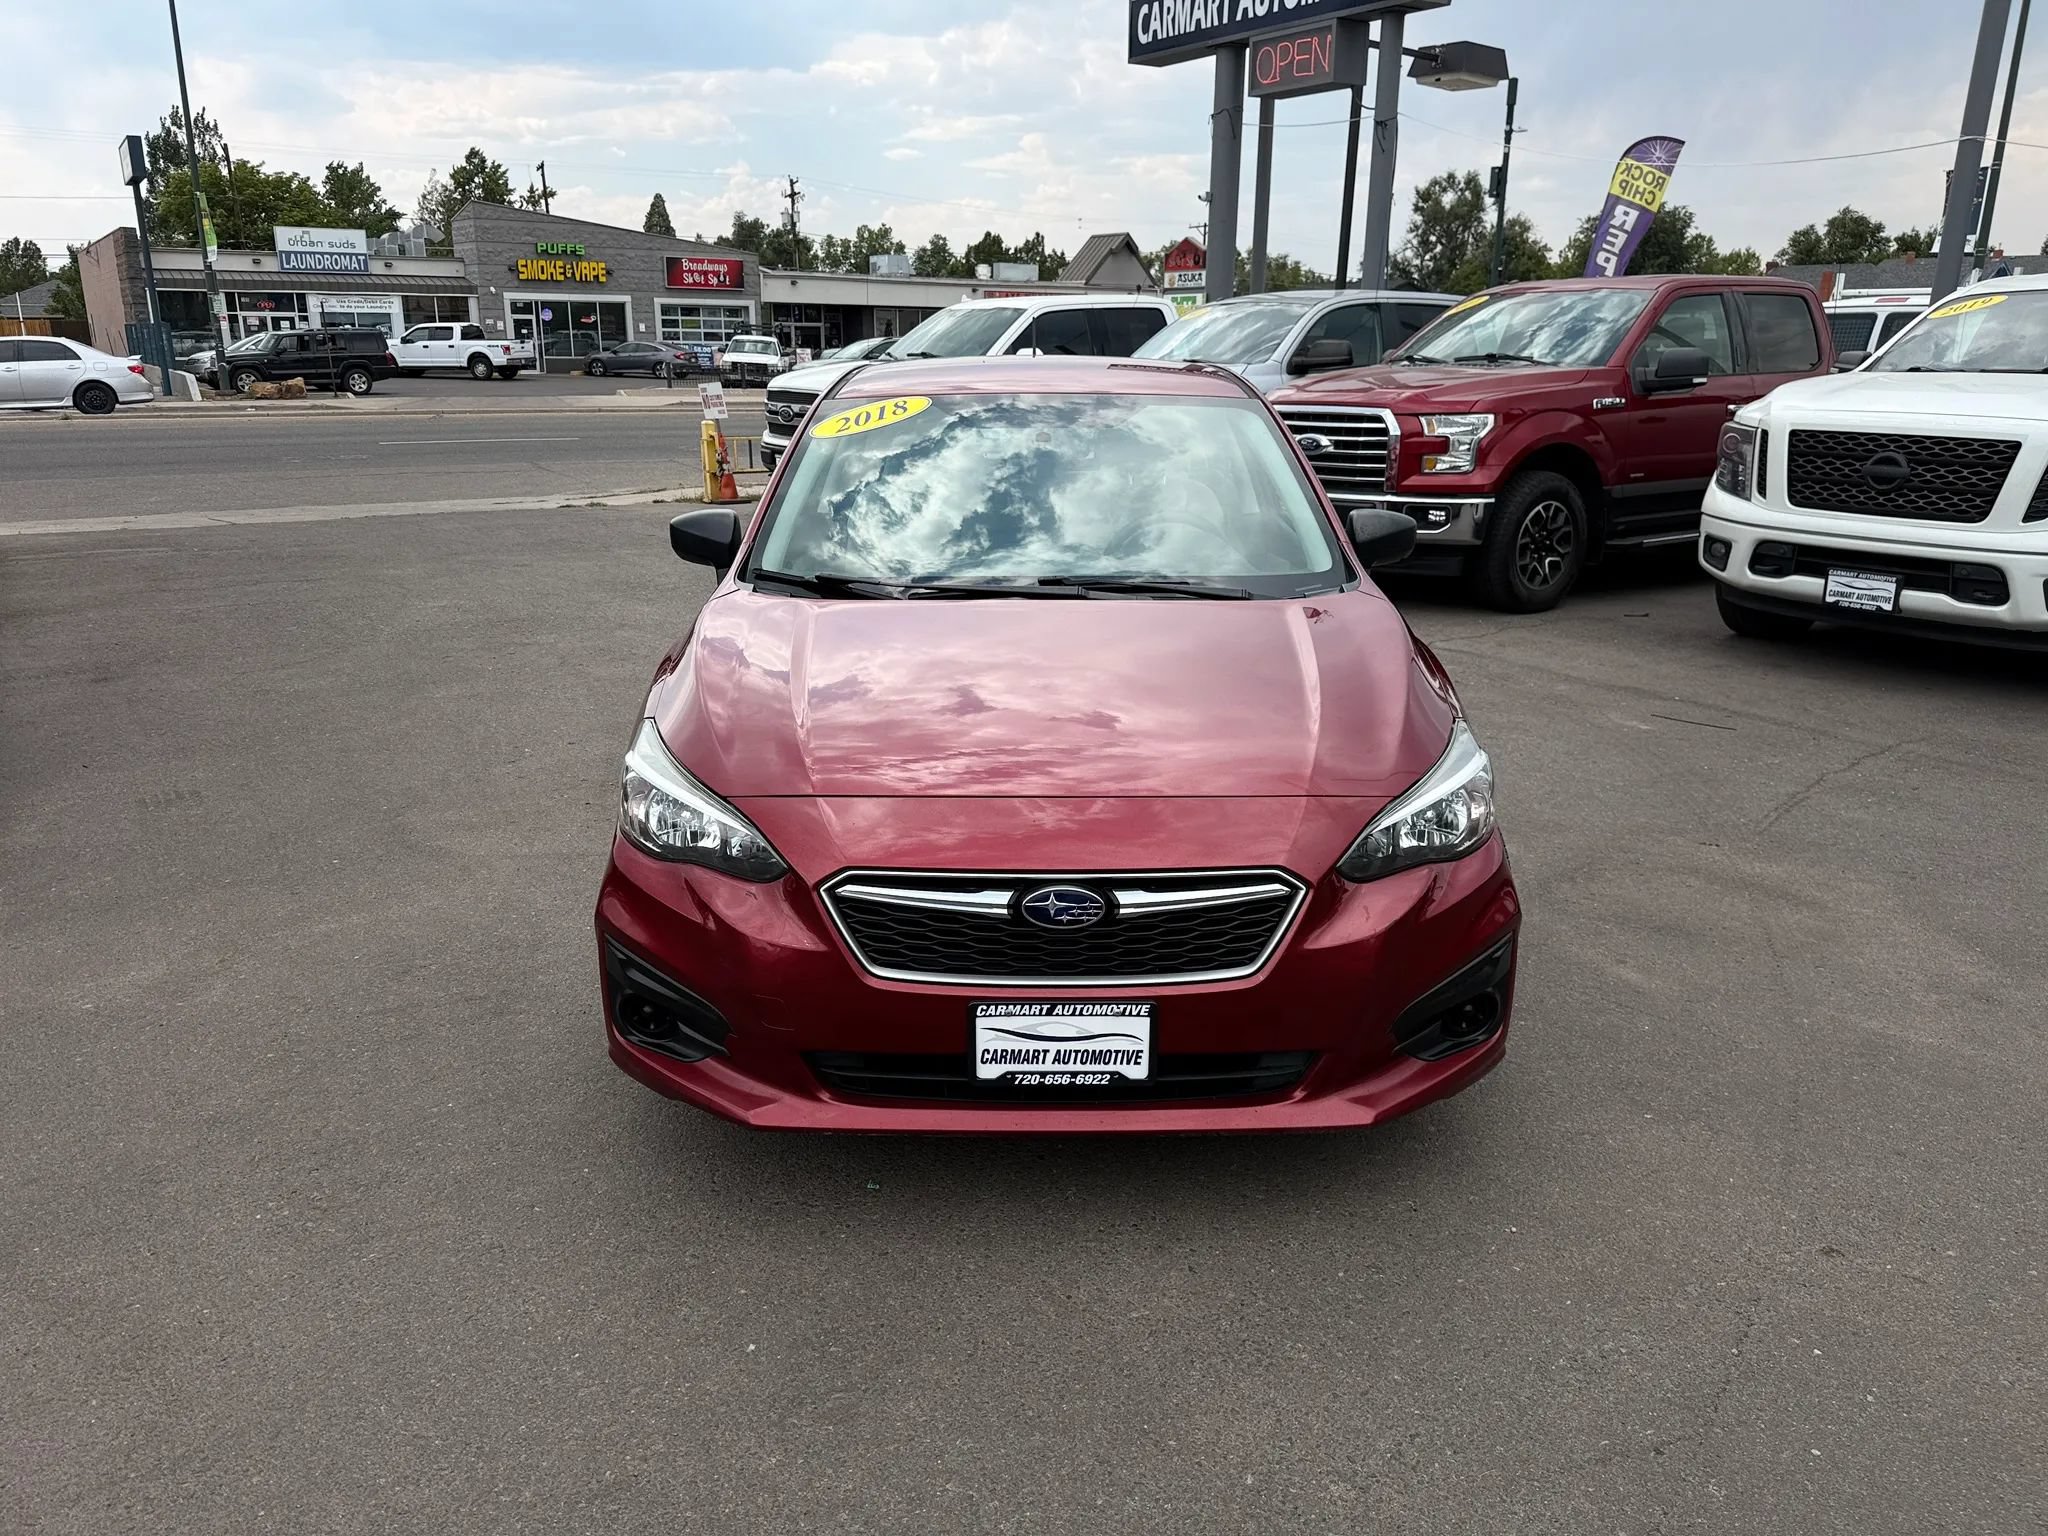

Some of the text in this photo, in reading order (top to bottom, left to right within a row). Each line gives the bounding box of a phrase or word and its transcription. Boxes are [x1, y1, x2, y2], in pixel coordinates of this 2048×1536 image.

[1137, 0, 1230, 45] CARMART
[1256, 34, 1332, 84] OPEN
[287, 233, 357, 250] urban suds
[536, 242, 586, 256] PUFFS
[282, 253, 366, 271] LAUNDROMAT
[681, 258, 728, 274] Broadways
[517, 259, 607, 283] SMOKE & VAPE
[1177, 272, 1203, 284] ASUKA
[835, 399, 909, 434] 2018
[1828, 589, 1893, 604] CARMART AUTOMOTIVE
[976, 1004, 1151, 1016] CARMART AUTOMOTIVE
[980, 1049, 1144, 1066] CARMART AUTOMOTIVE
[1014, 1073, 1111, 1085] 720-656-6922
